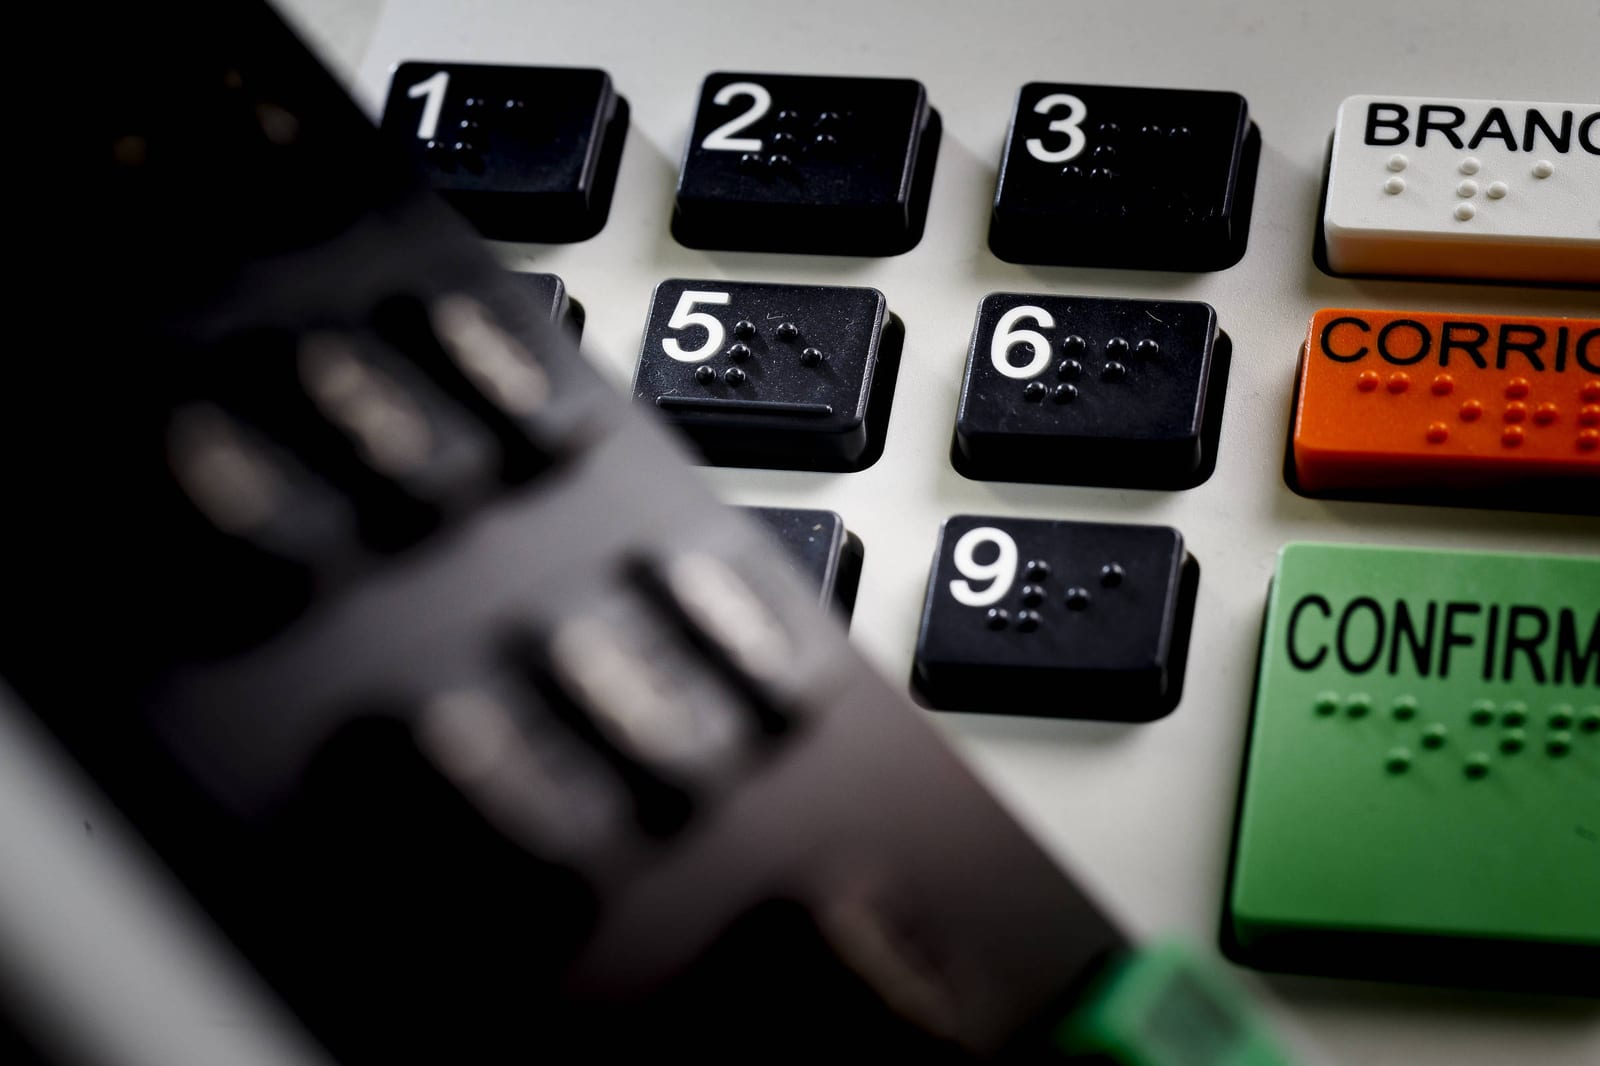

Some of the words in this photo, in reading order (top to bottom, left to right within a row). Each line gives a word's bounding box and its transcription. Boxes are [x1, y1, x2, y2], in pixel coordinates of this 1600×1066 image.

[406, 71, 450, 140] 1
[700, 82, 772, 152] 2
[1025, 93, 1088, 164] 3
[660, 290, 732, 365] 5
[990, 305, 1057, 380] 6
[948, 527, 1019, 608] 9
[1285, 593, 1600, 688] CONFIRM
